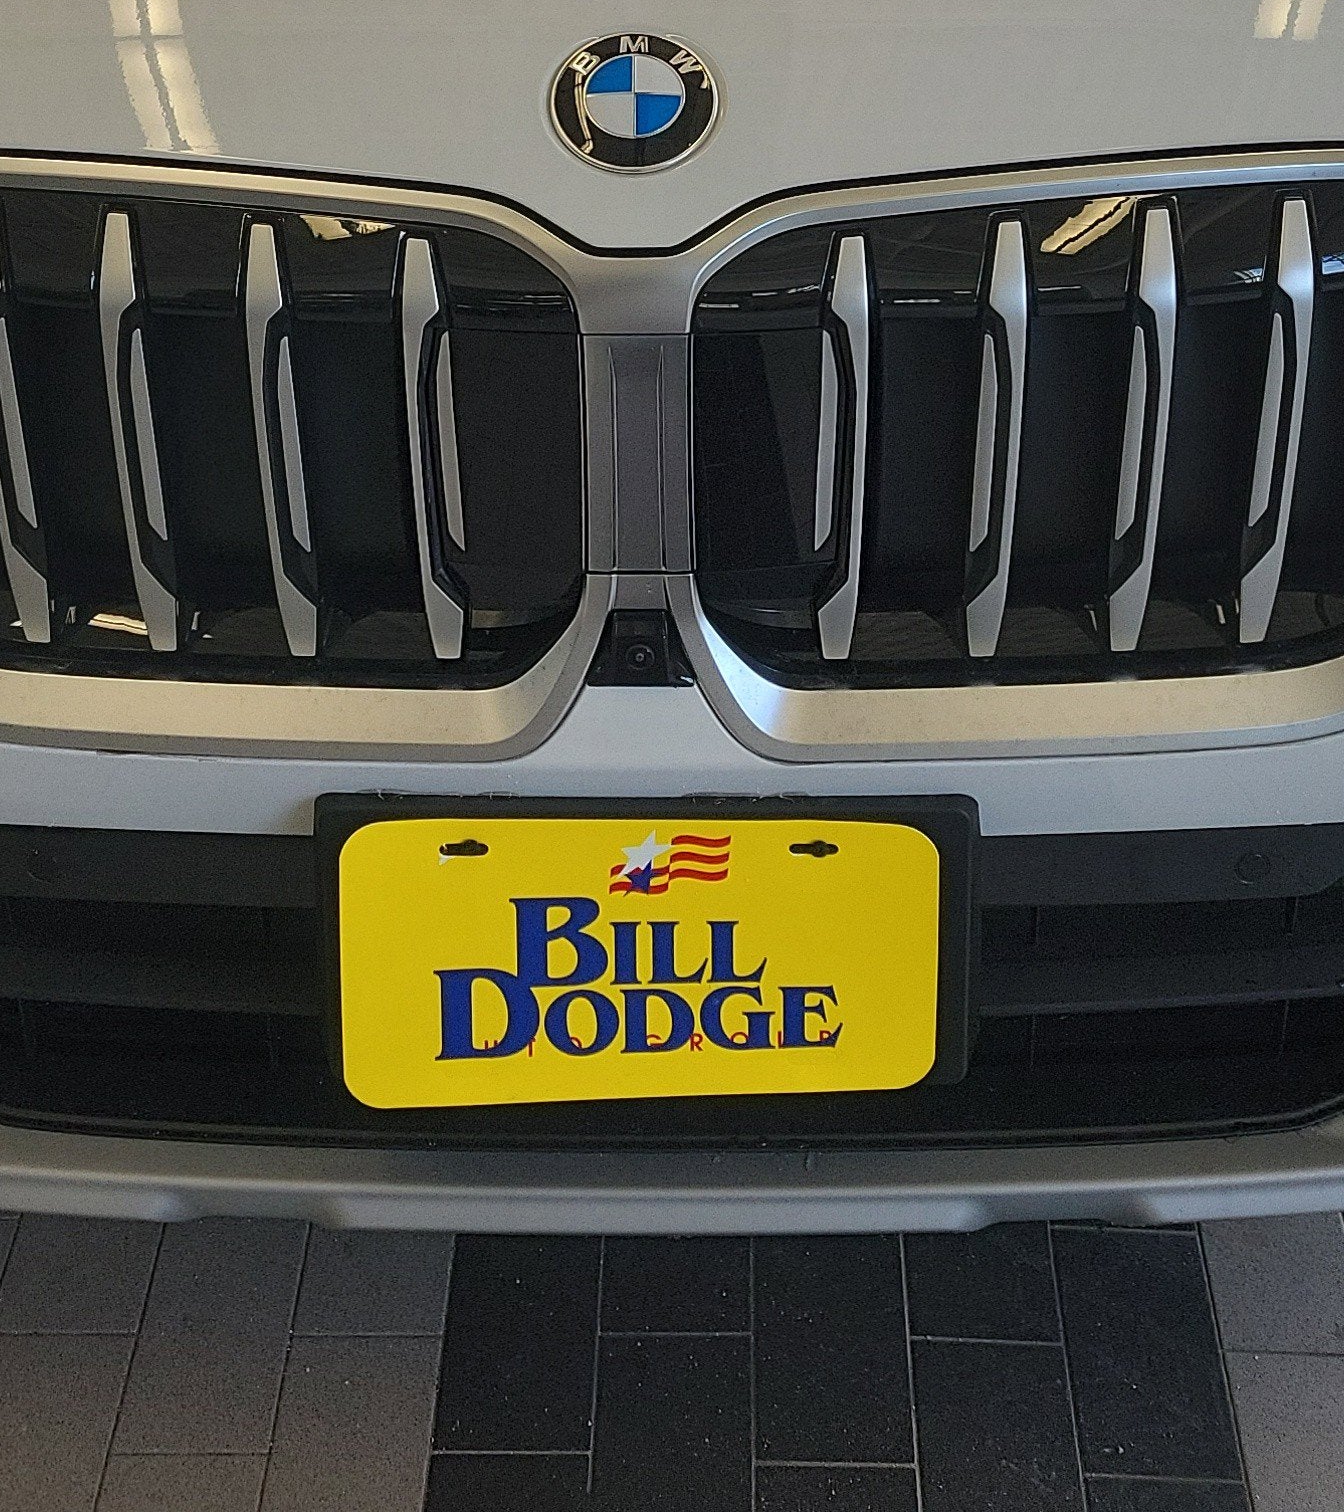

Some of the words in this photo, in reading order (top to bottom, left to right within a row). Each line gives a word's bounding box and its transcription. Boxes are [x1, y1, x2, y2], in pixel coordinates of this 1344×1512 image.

[569, 35, 704, 76] BMW
[508, 896, 768, 988] BILL
[433, 967, 844, 1061] DODGE
